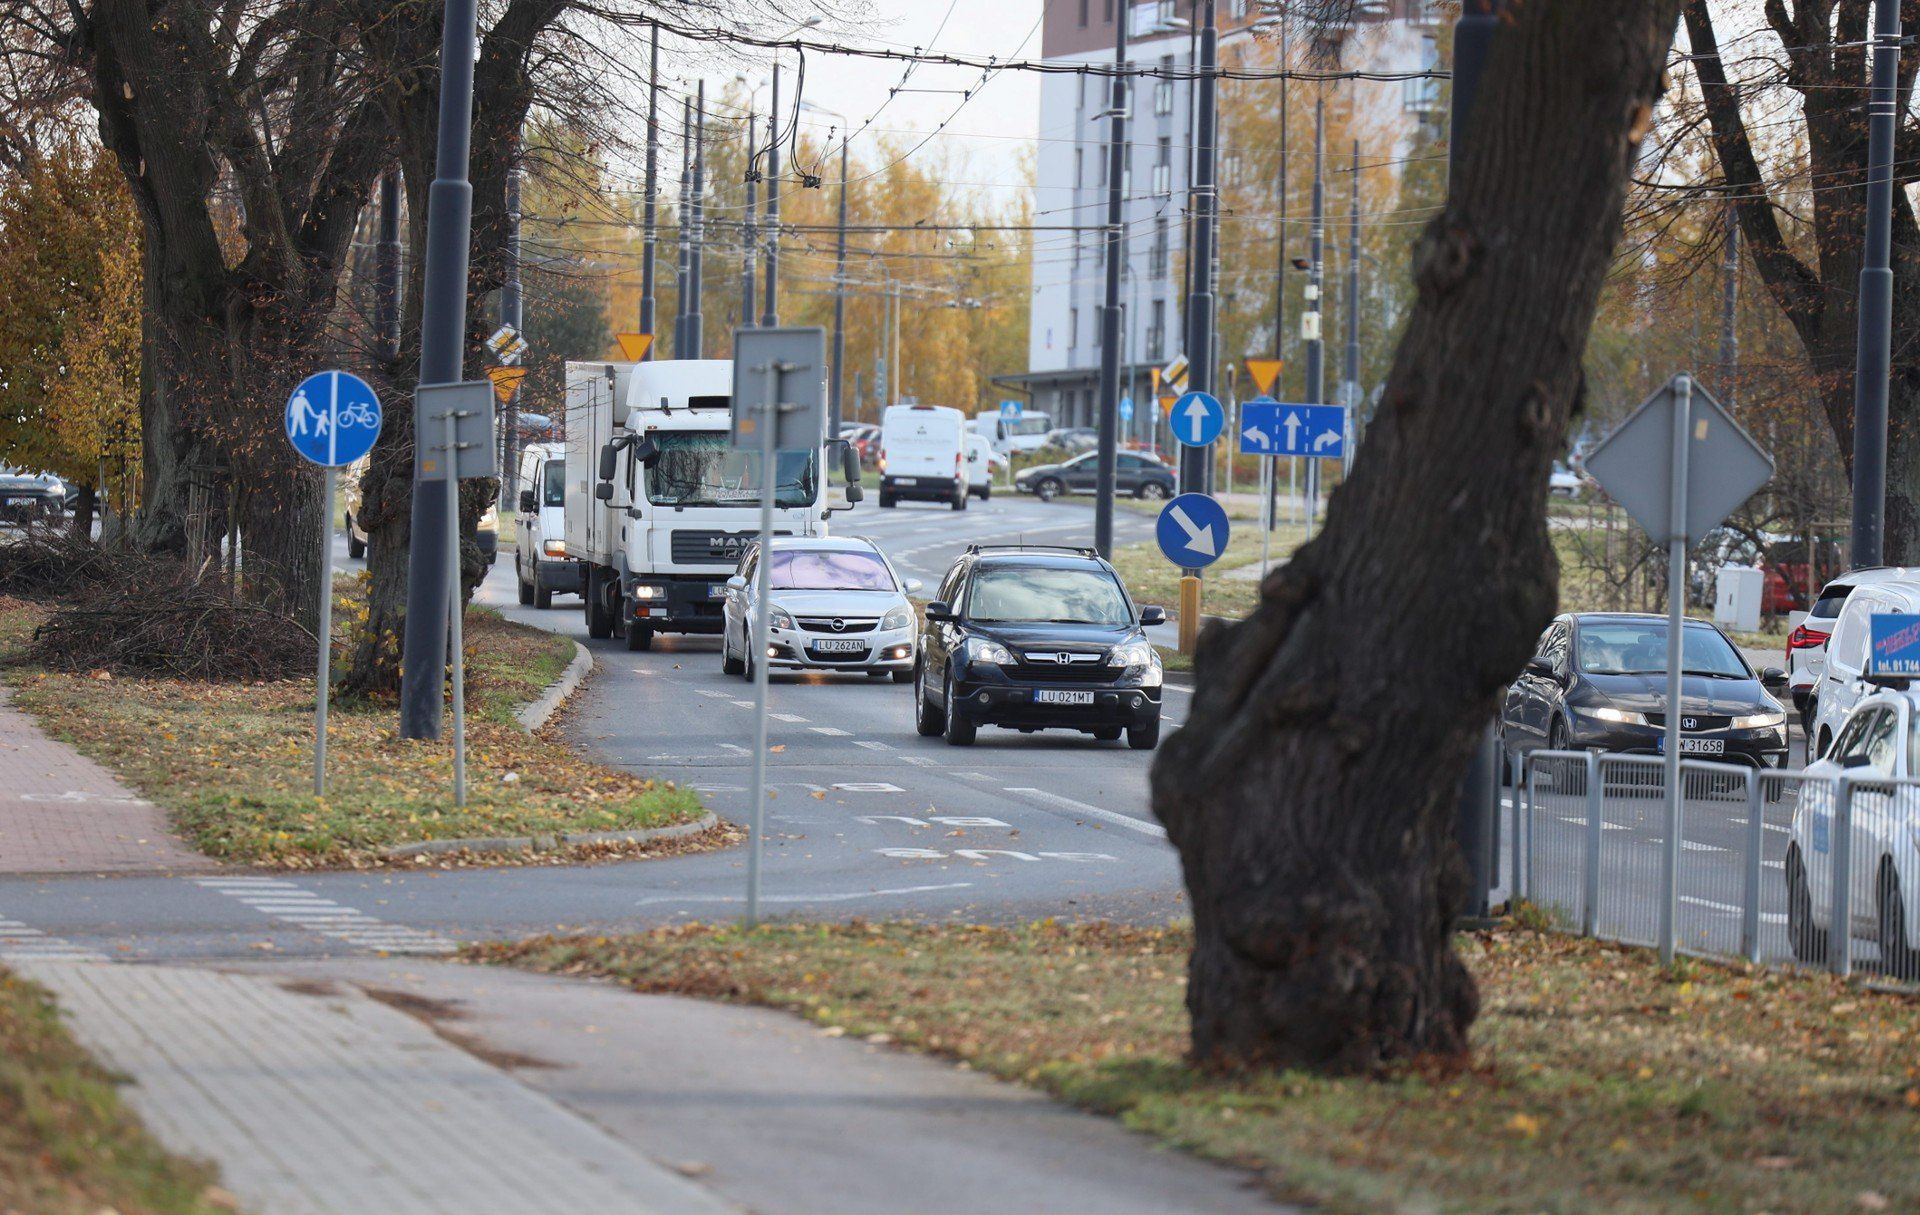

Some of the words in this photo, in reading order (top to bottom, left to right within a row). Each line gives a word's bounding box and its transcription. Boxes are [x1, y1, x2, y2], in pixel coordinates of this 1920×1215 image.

[819, 641, 832, 650] LU
[835, 641, 864, 651] 262AN
[1041, 691, 1056, 702] LU
[1058, 691, 1092, 703] 021MT
[1688, 740, 1723, 752] 31658
